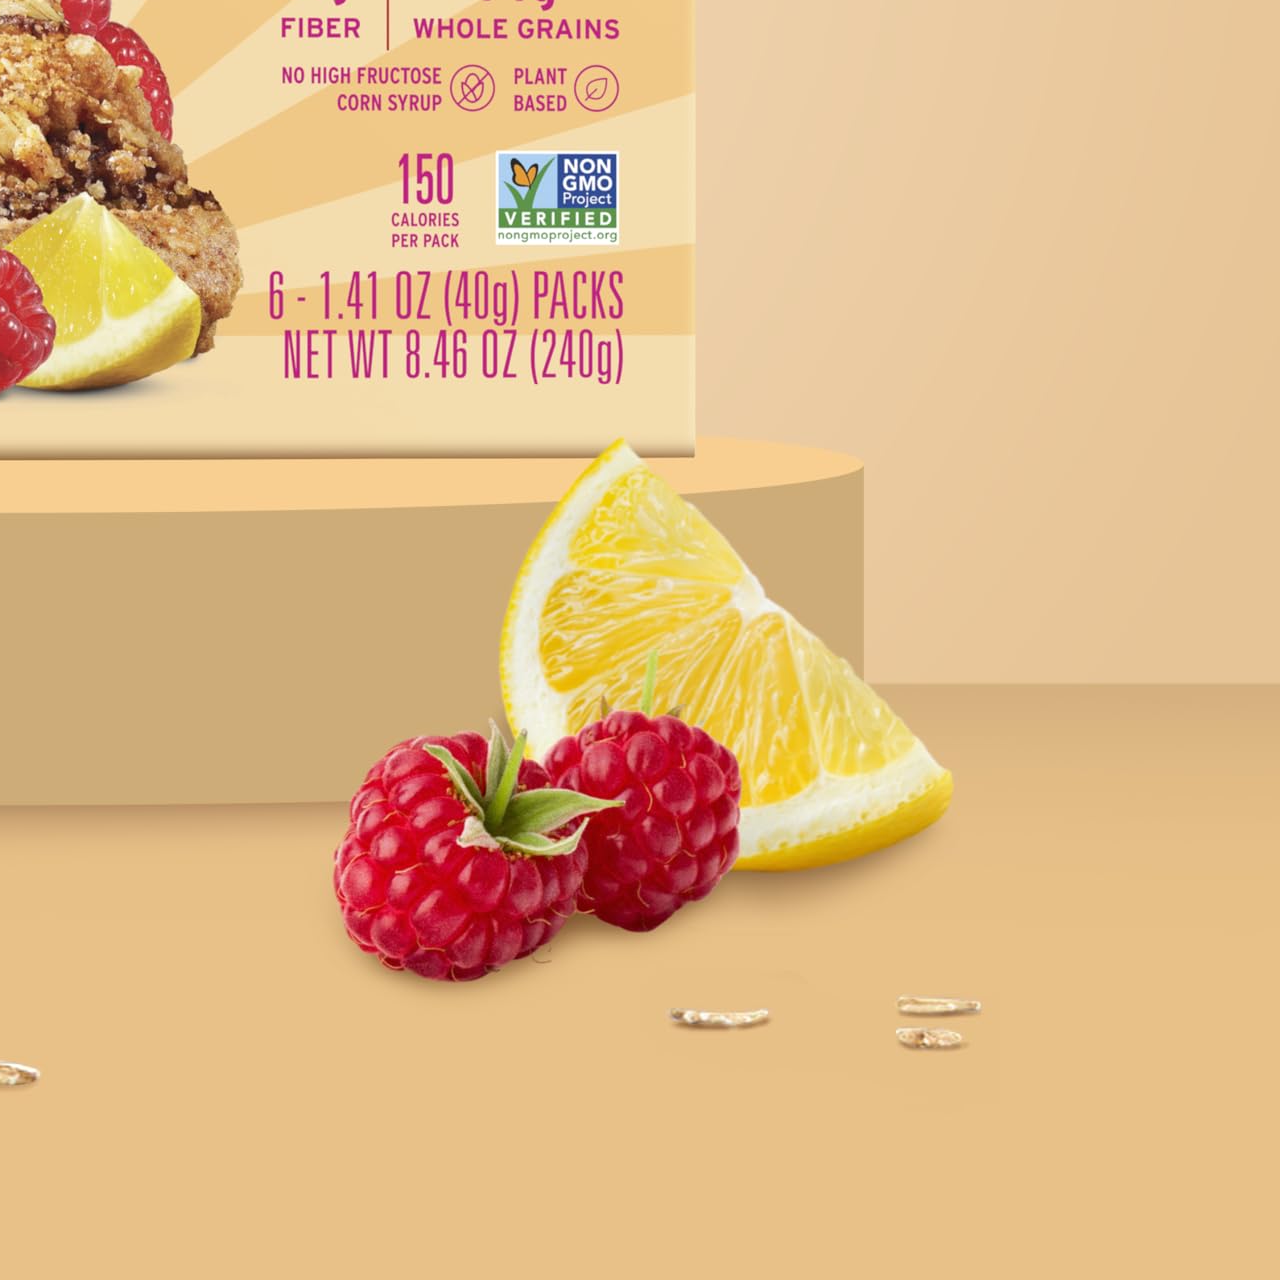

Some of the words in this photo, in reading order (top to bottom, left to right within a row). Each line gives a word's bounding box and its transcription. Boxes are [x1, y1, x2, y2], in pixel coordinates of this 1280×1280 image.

[281, 17, 361, 39] FIBER
[414, 18, 507, 39] WHOLE
[517, 18, 619, 40] GRAINS
[281, 66, 305, 85] NO
[311, 65, 351, 84] HIGH
[357, 66, 441, 85] FRUCTOSE
[513, 67, 566, 85] PLANT
[337, 93, 382, 111] CORN
[387, 94, 443, 112] SYRUP
[513, 94, 567, 112] BASED
[564, 158, 611, 174] NON
[399, 153, 454, 205] 150
[562, 175, 613, 191] GMO
[563, 192, 611, 208] Project
[391, 212, 458, 227] CALORIES
[505, 211, 612, 226] VERIFIED
[391, 233, 418, 248] PER
[423, 233, 458, 247] PACK
[496, 229, 619, 244] nongmoproject.org
[268, 270, 285, 320] 6
[320, 271, 378, 320] 1.41
[395, 271, 431, 320] OZ
[444, 271, 519, 327] (40g)
[533, 271, 624, 320] PACKS
[283, 329, 337, 380] NET
[347, 329, 392, 380] WT
[405, 328, 468, 379] 8.46
[481, 328, 518, 379] OZ
[530, 328, 624, 385] (240g)
